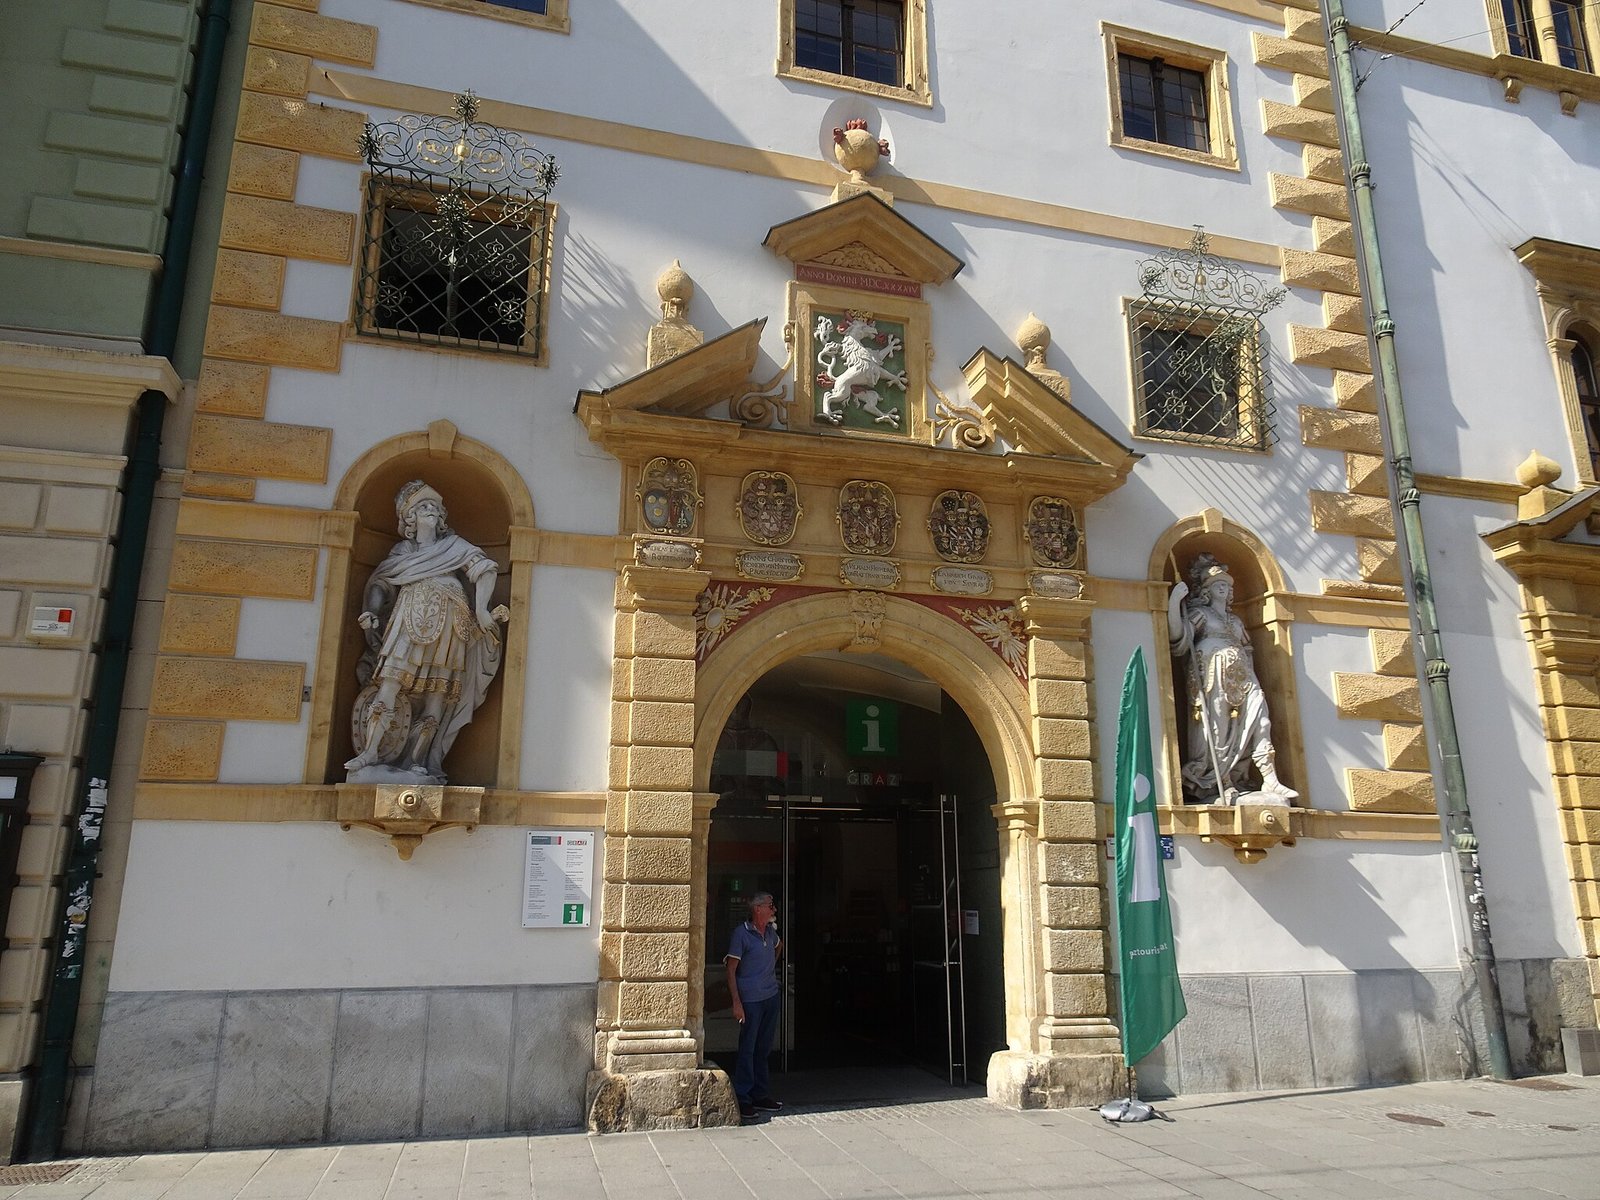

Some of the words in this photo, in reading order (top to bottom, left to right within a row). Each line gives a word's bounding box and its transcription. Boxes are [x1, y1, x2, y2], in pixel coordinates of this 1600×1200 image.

[800, 267, 825, 280] ANNO
[826, 271, 857, 285] DOMINI
[848, 773, 898, 786] GRAZ
